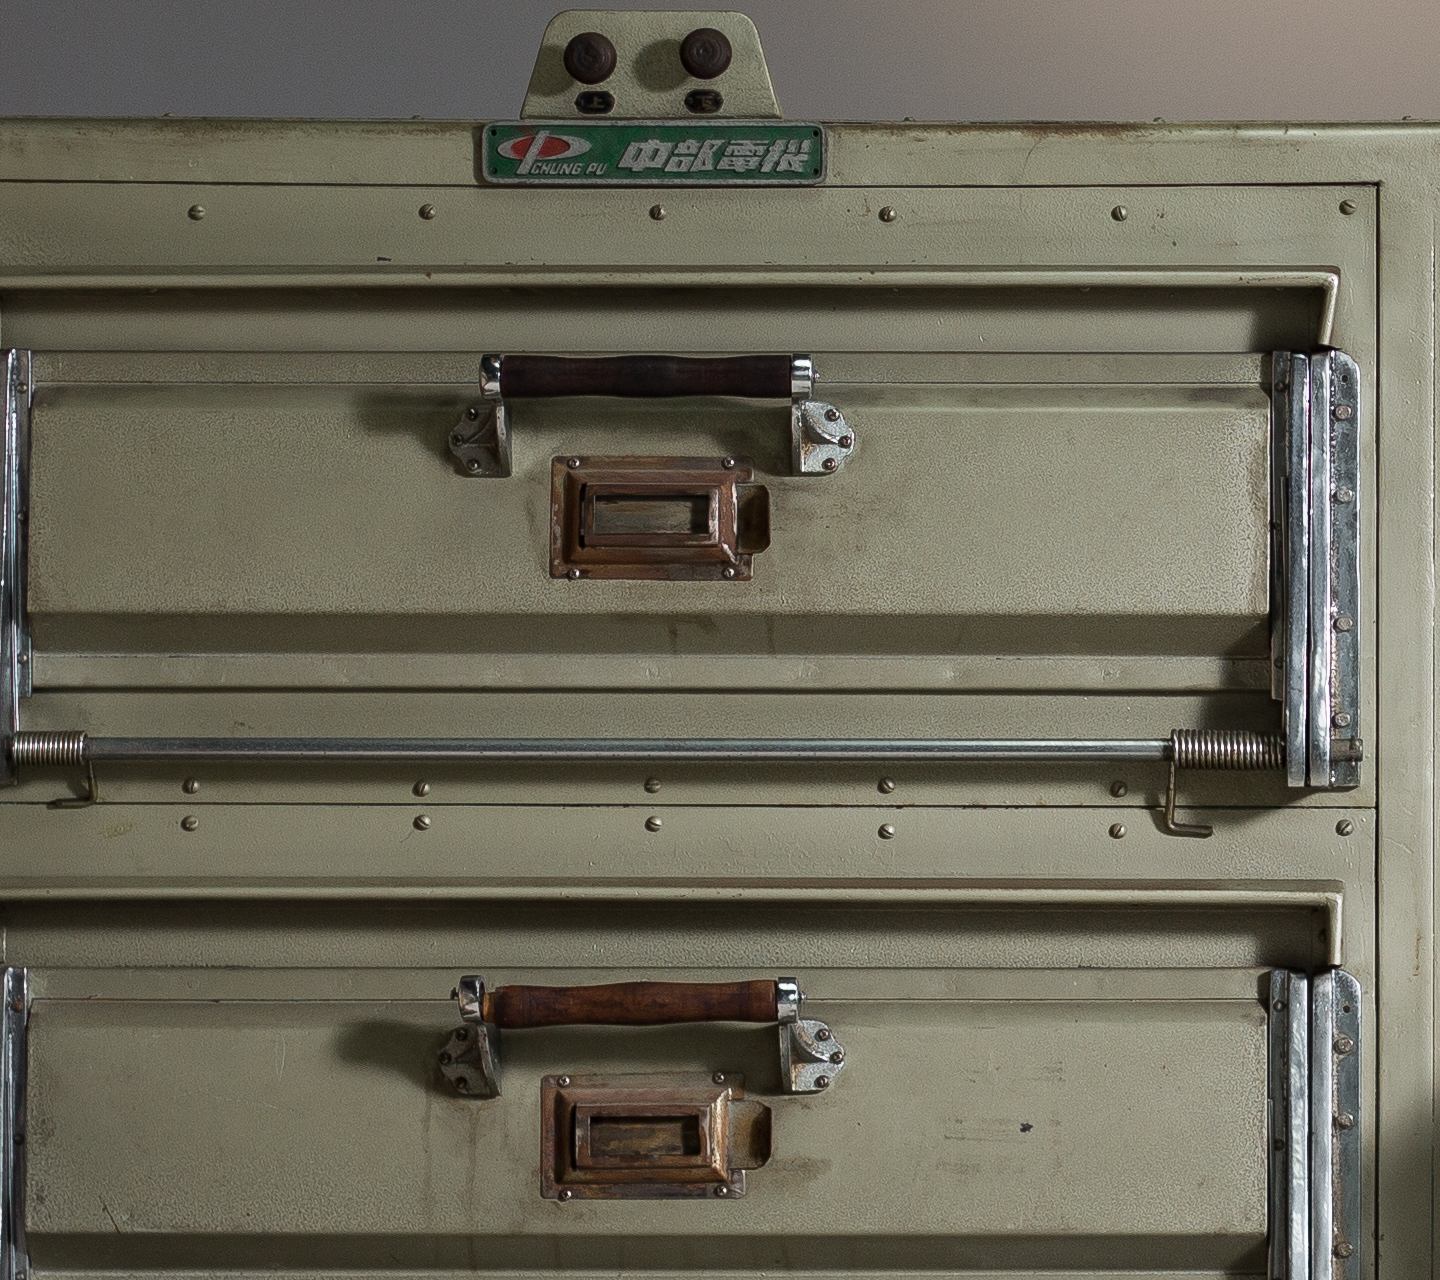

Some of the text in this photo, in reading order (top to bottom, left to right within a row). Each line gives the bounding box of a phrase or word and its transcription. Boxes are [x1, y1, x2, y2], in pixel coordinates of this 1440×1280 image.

[619, 138, 811, 173] 中部電機
[529, 161, 607, 175] CHUNG PU
